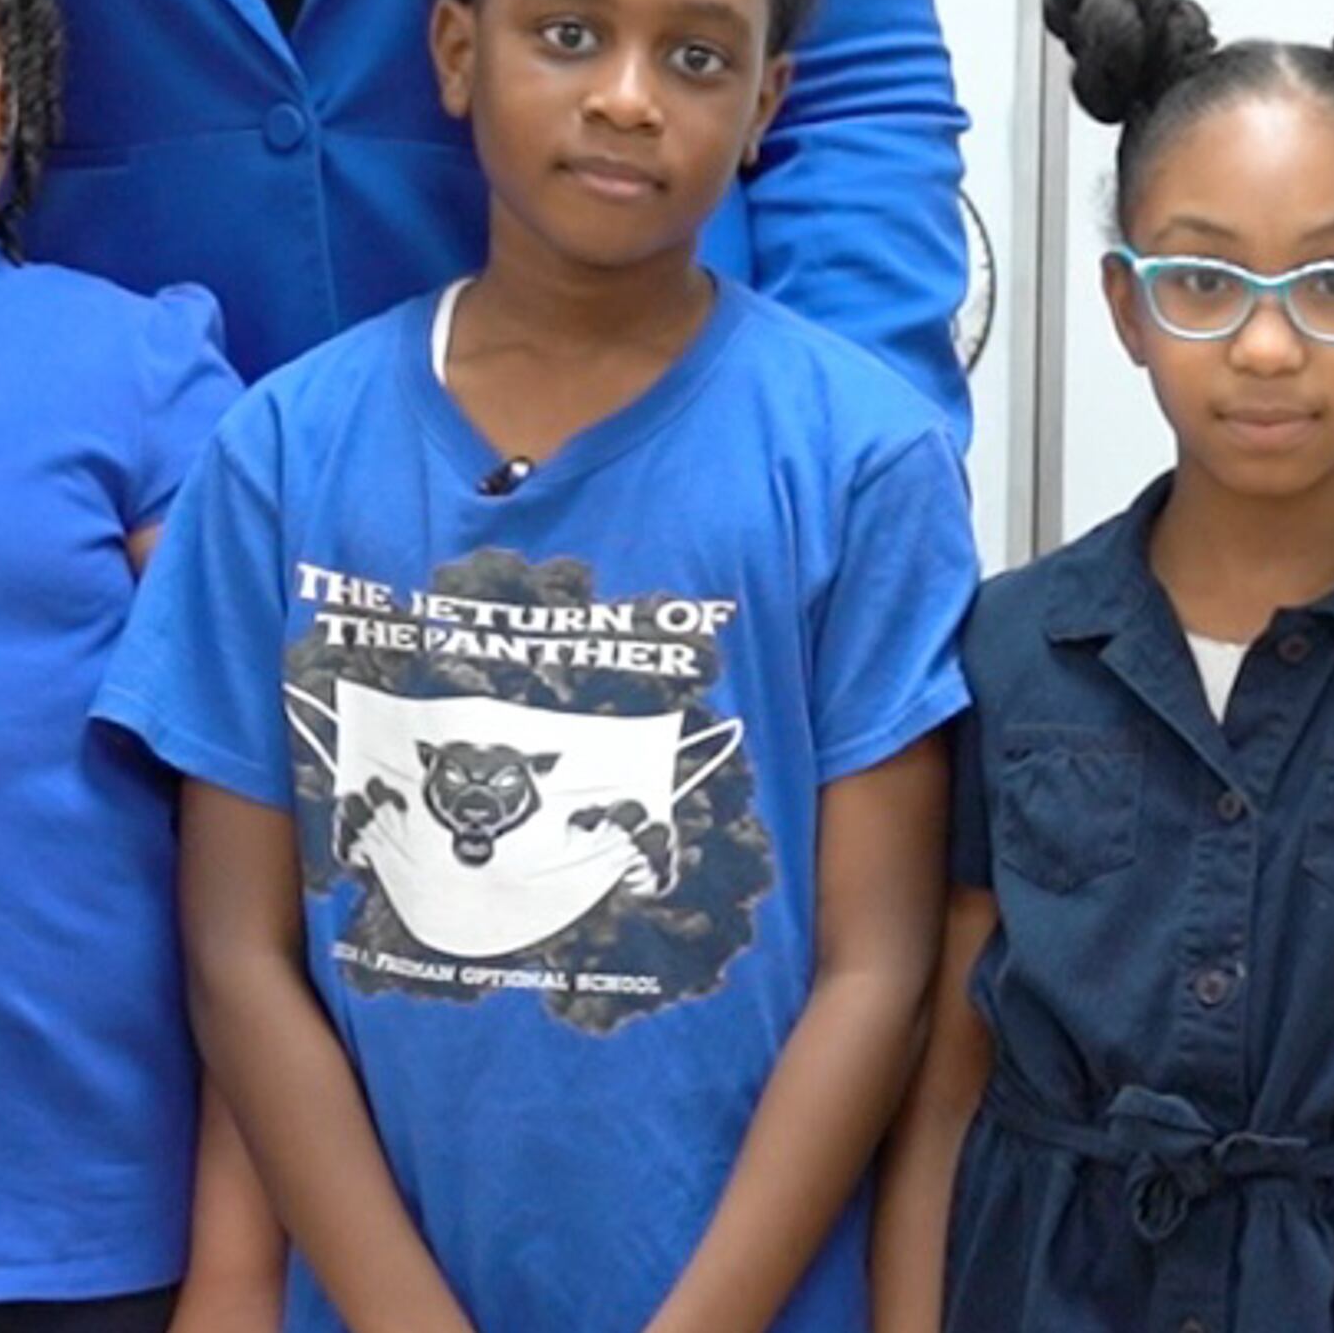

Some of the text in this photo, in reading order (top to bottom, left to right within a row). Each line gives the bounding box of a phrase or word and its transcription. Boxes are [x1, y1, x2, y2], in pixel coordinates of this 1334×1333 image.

[296, 561, 392, 614] THE
[656, 599, 737, 637] OF
[315, 612, 417, 652] THE
[575, 973, 663, 995] SCHOOL
